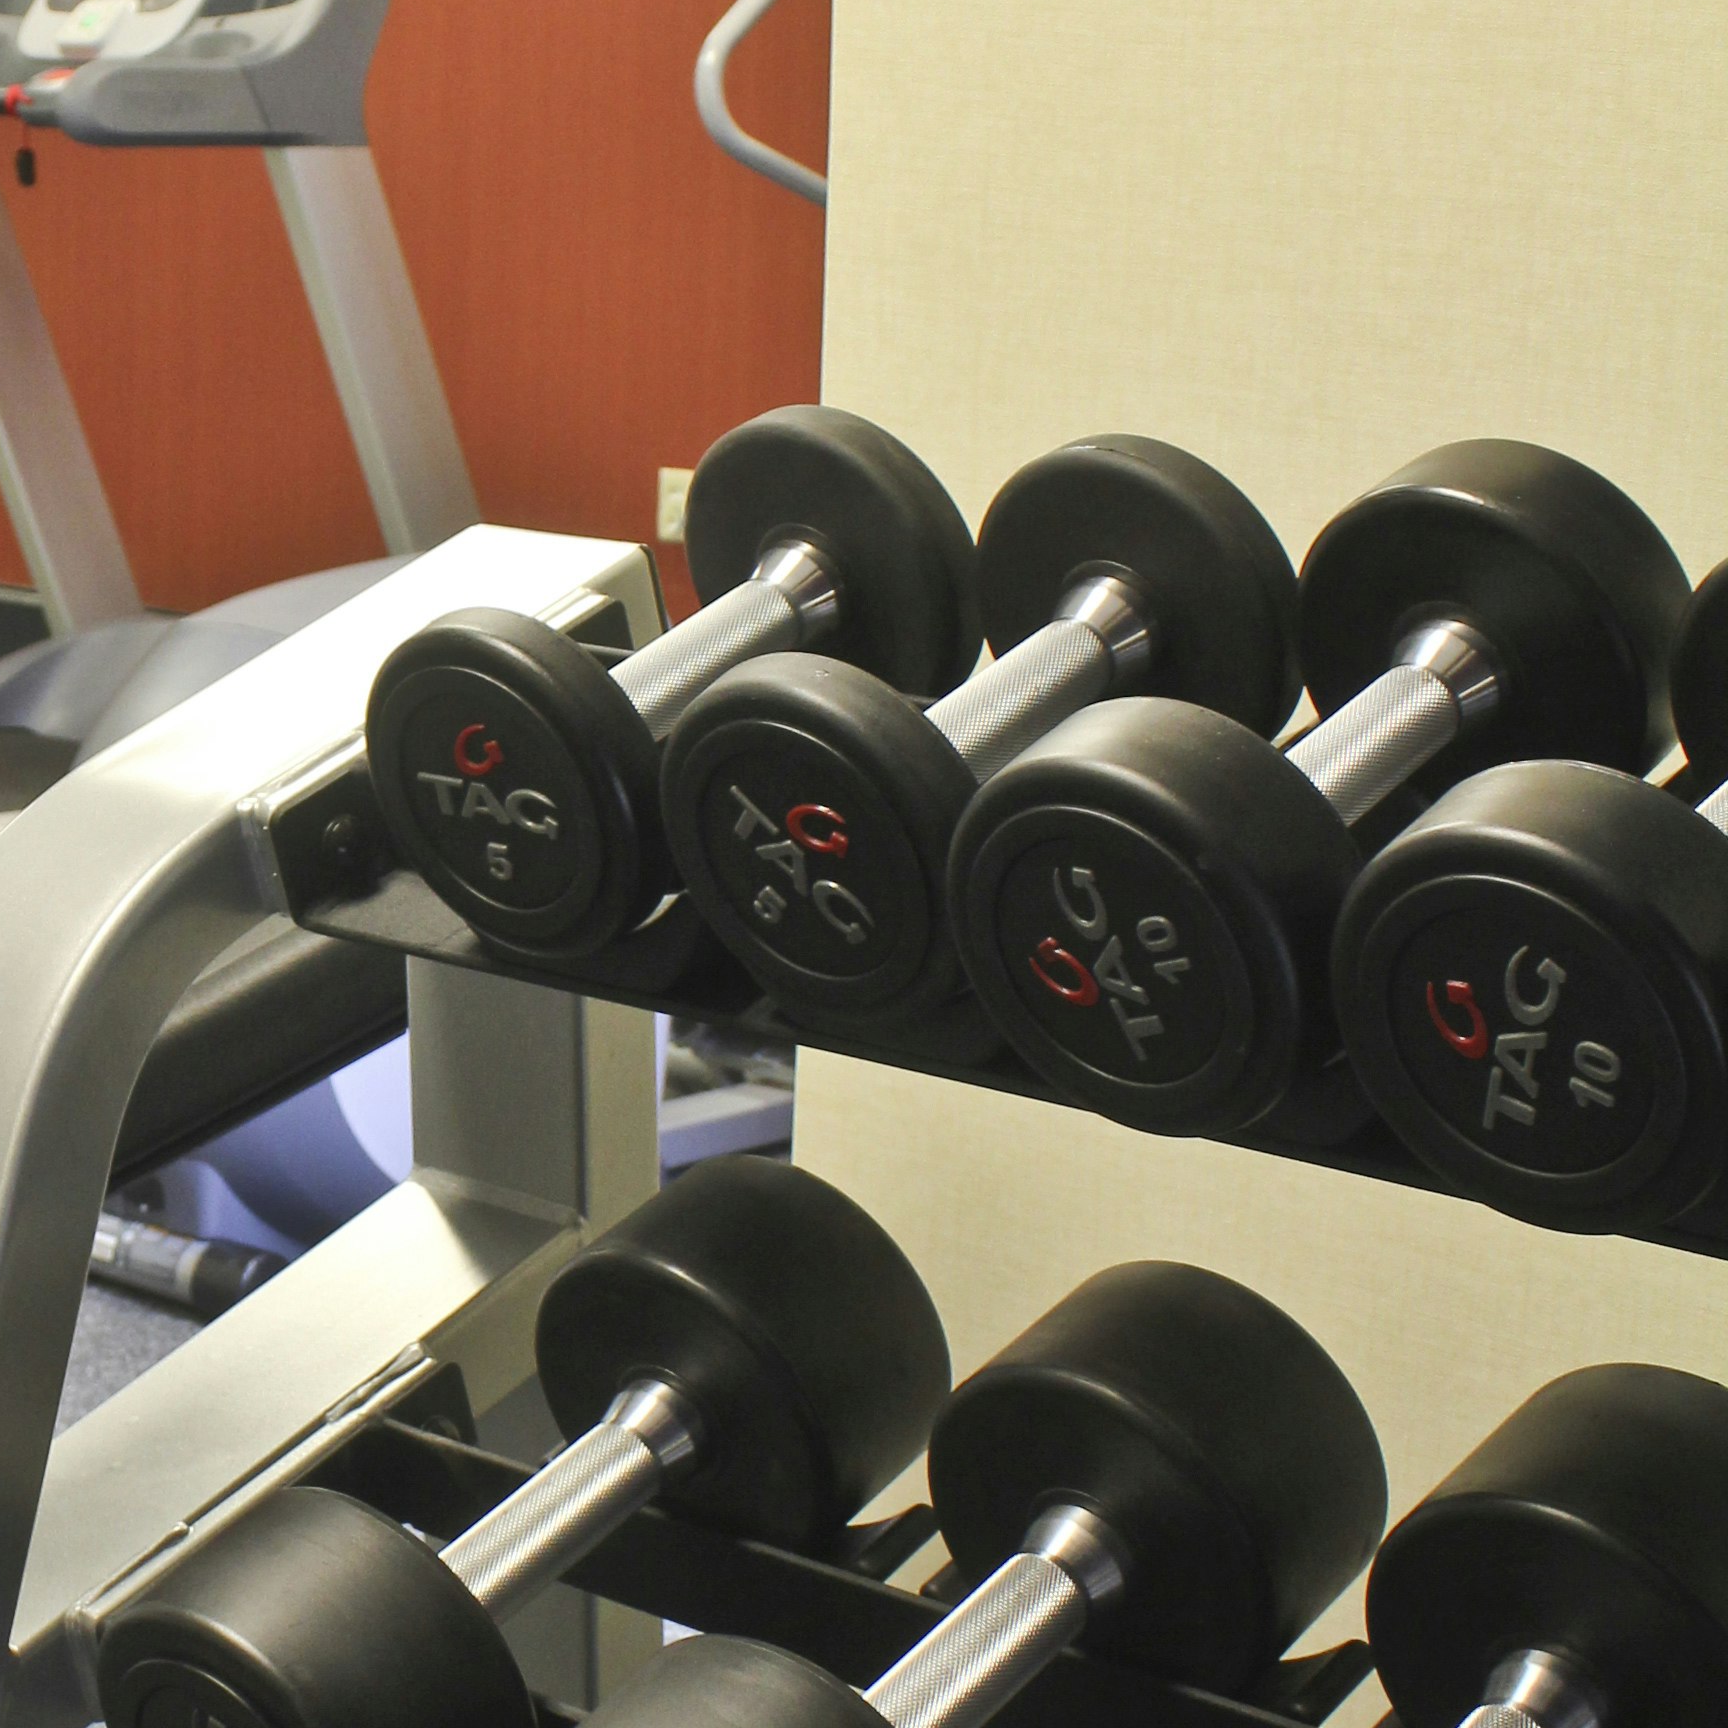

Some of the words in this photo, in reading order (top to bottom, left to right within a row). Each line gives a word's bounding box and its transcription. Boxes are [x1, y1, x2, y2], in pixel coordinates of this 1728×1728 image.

[488, 843, 514, 881] 5
[1136, 915, 1191, 985] 10
[1569, 1041, 1622, 1108] 10
